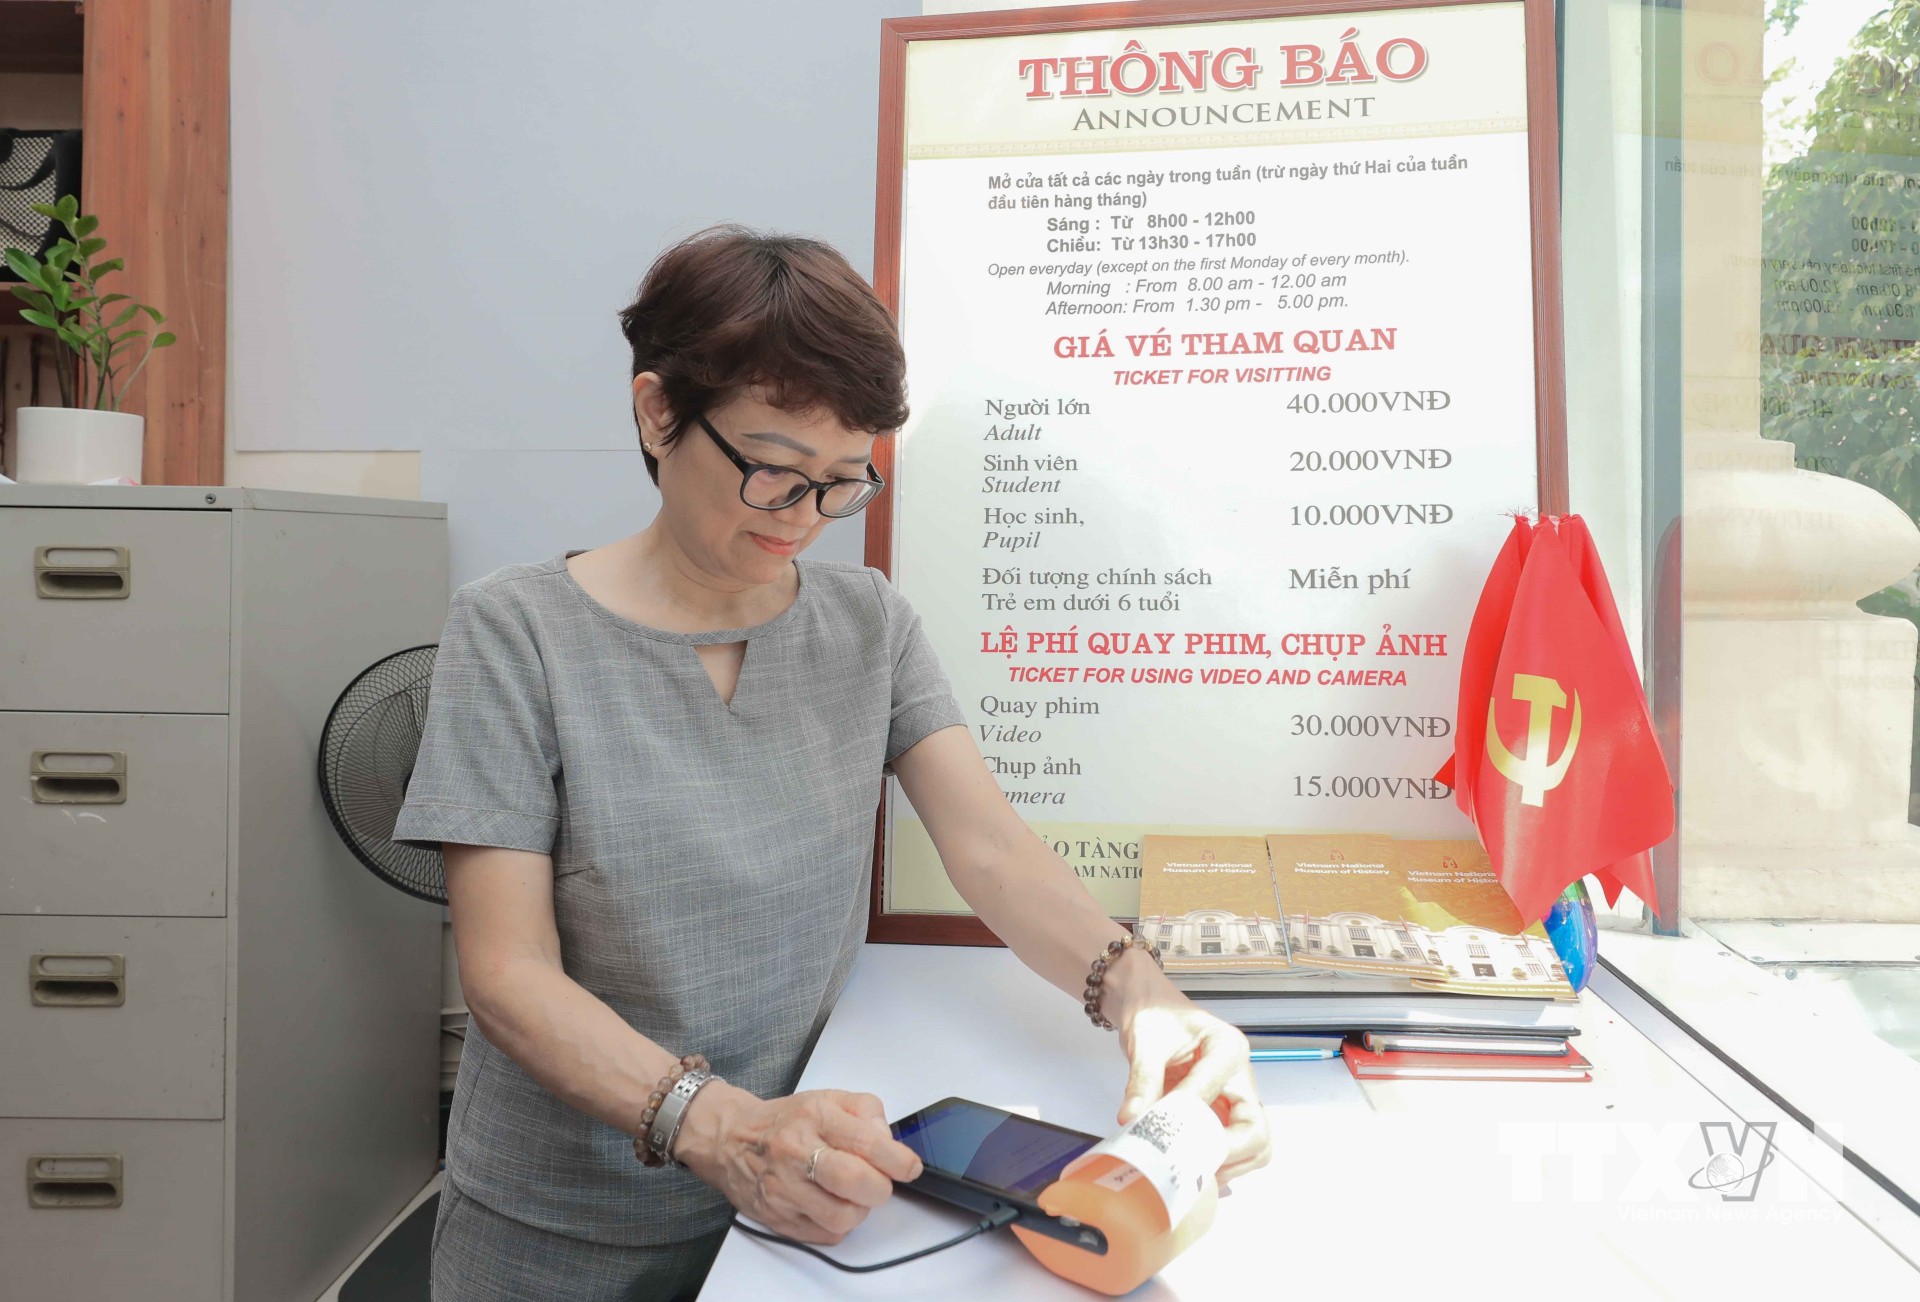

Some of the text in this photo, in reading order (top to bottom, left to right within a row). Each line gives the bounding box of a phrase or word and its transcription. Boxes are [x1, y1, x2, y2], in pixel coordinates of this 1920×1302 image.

[1019, 27, 1426, 97] THÔNG BÁO
[1072, 97, 1375, 131] ANNOUNCEMENT
[989, 154, 1467, 189] Mở cửa tất cả các ngày trong tuần (trừ ngày thứ Hai của tuần
[988, 191, 1146, 210] đầu tiên hàng tháng)
[1047, 217, 1089, 234] Sáng
[1111, 216, 1133, 229] Từ
[1147, 213, 1187, 228] 8h00
[1205, 211, 1255, 226] 12h00
[1047, 236, 1100, 253] Chiều:
[1111, 237, 1134, 250] Từ
[1139, 235, 1188, 250] 13h30
[1206, 233, 1256, 247] 17h00
[988, 250, 1409, 278] Open everyday (except on the first Monday of every month).
[1047, 281, 1111, 297] Morning
[1136, 279, 1177, 292] From
[1188, 277, 1223, 291] 8.00
[1228, 279, 1253, 290] am
[1272, 274, 1316, 288] 12.00
[1321, 276, 1346, 287] am
[1045, 301, 1127, 315] Afternoon:
[1133, 299, 1174, 313] From
[1187, 297, 1220, 311] 1.30
[1224, 300, 1250, 314] pm
[1278, 294, 1313, 309] 5.00
[1318, 296, 1347, 311] pm.
[1054, 327, 1397, 358] GIÁ VÉ THAM QUAN
[1114, 366, 1331, 385] TICKET FOR VISITTING
[985, 399, 1091, 420] Người lớn
[1287, 391, 1450, 413] 40.000VNĐ
[983, 424, 1042, 440] Adult
[984, 454, 1078, 471] Sinh viên
[1290, 449, 1452, 471] 20.000VNĐ
[982, 476, 1061, 493] Student
[984, 508, 1084, 528] Học sinh,
[1292, 504, 1453, 525] 10.000VNĐ
[982, 531, 1040, 552] Pupil
[982, 567, 1212, 589] Đối tượng chính sách
[1289, 567, 1411, 595] Miễn phí
[982, 591, 1179, 611] Trẻ em dưới 6 tuổi
[981, 624, 1447, 661] LỆ PHÍ QUAY PHIM, CHỤP ẢNH
[1009, 667, 1407, 686] TICKET FOR USING VIDEO AND CAMERA
[981, 696, 1099, 718] Quay phim
[979, 725, 1041, 742] Video
[1291, 713, 1452, 739] 30.000VNĐ
[1043, 756, 1081, 775] ảnh
[1293, 776, 1452, 800] 15.000VNĐ
[1076, 837, 1139, 859] TÀNG
[1100, 865, 1142, 879] NATI
